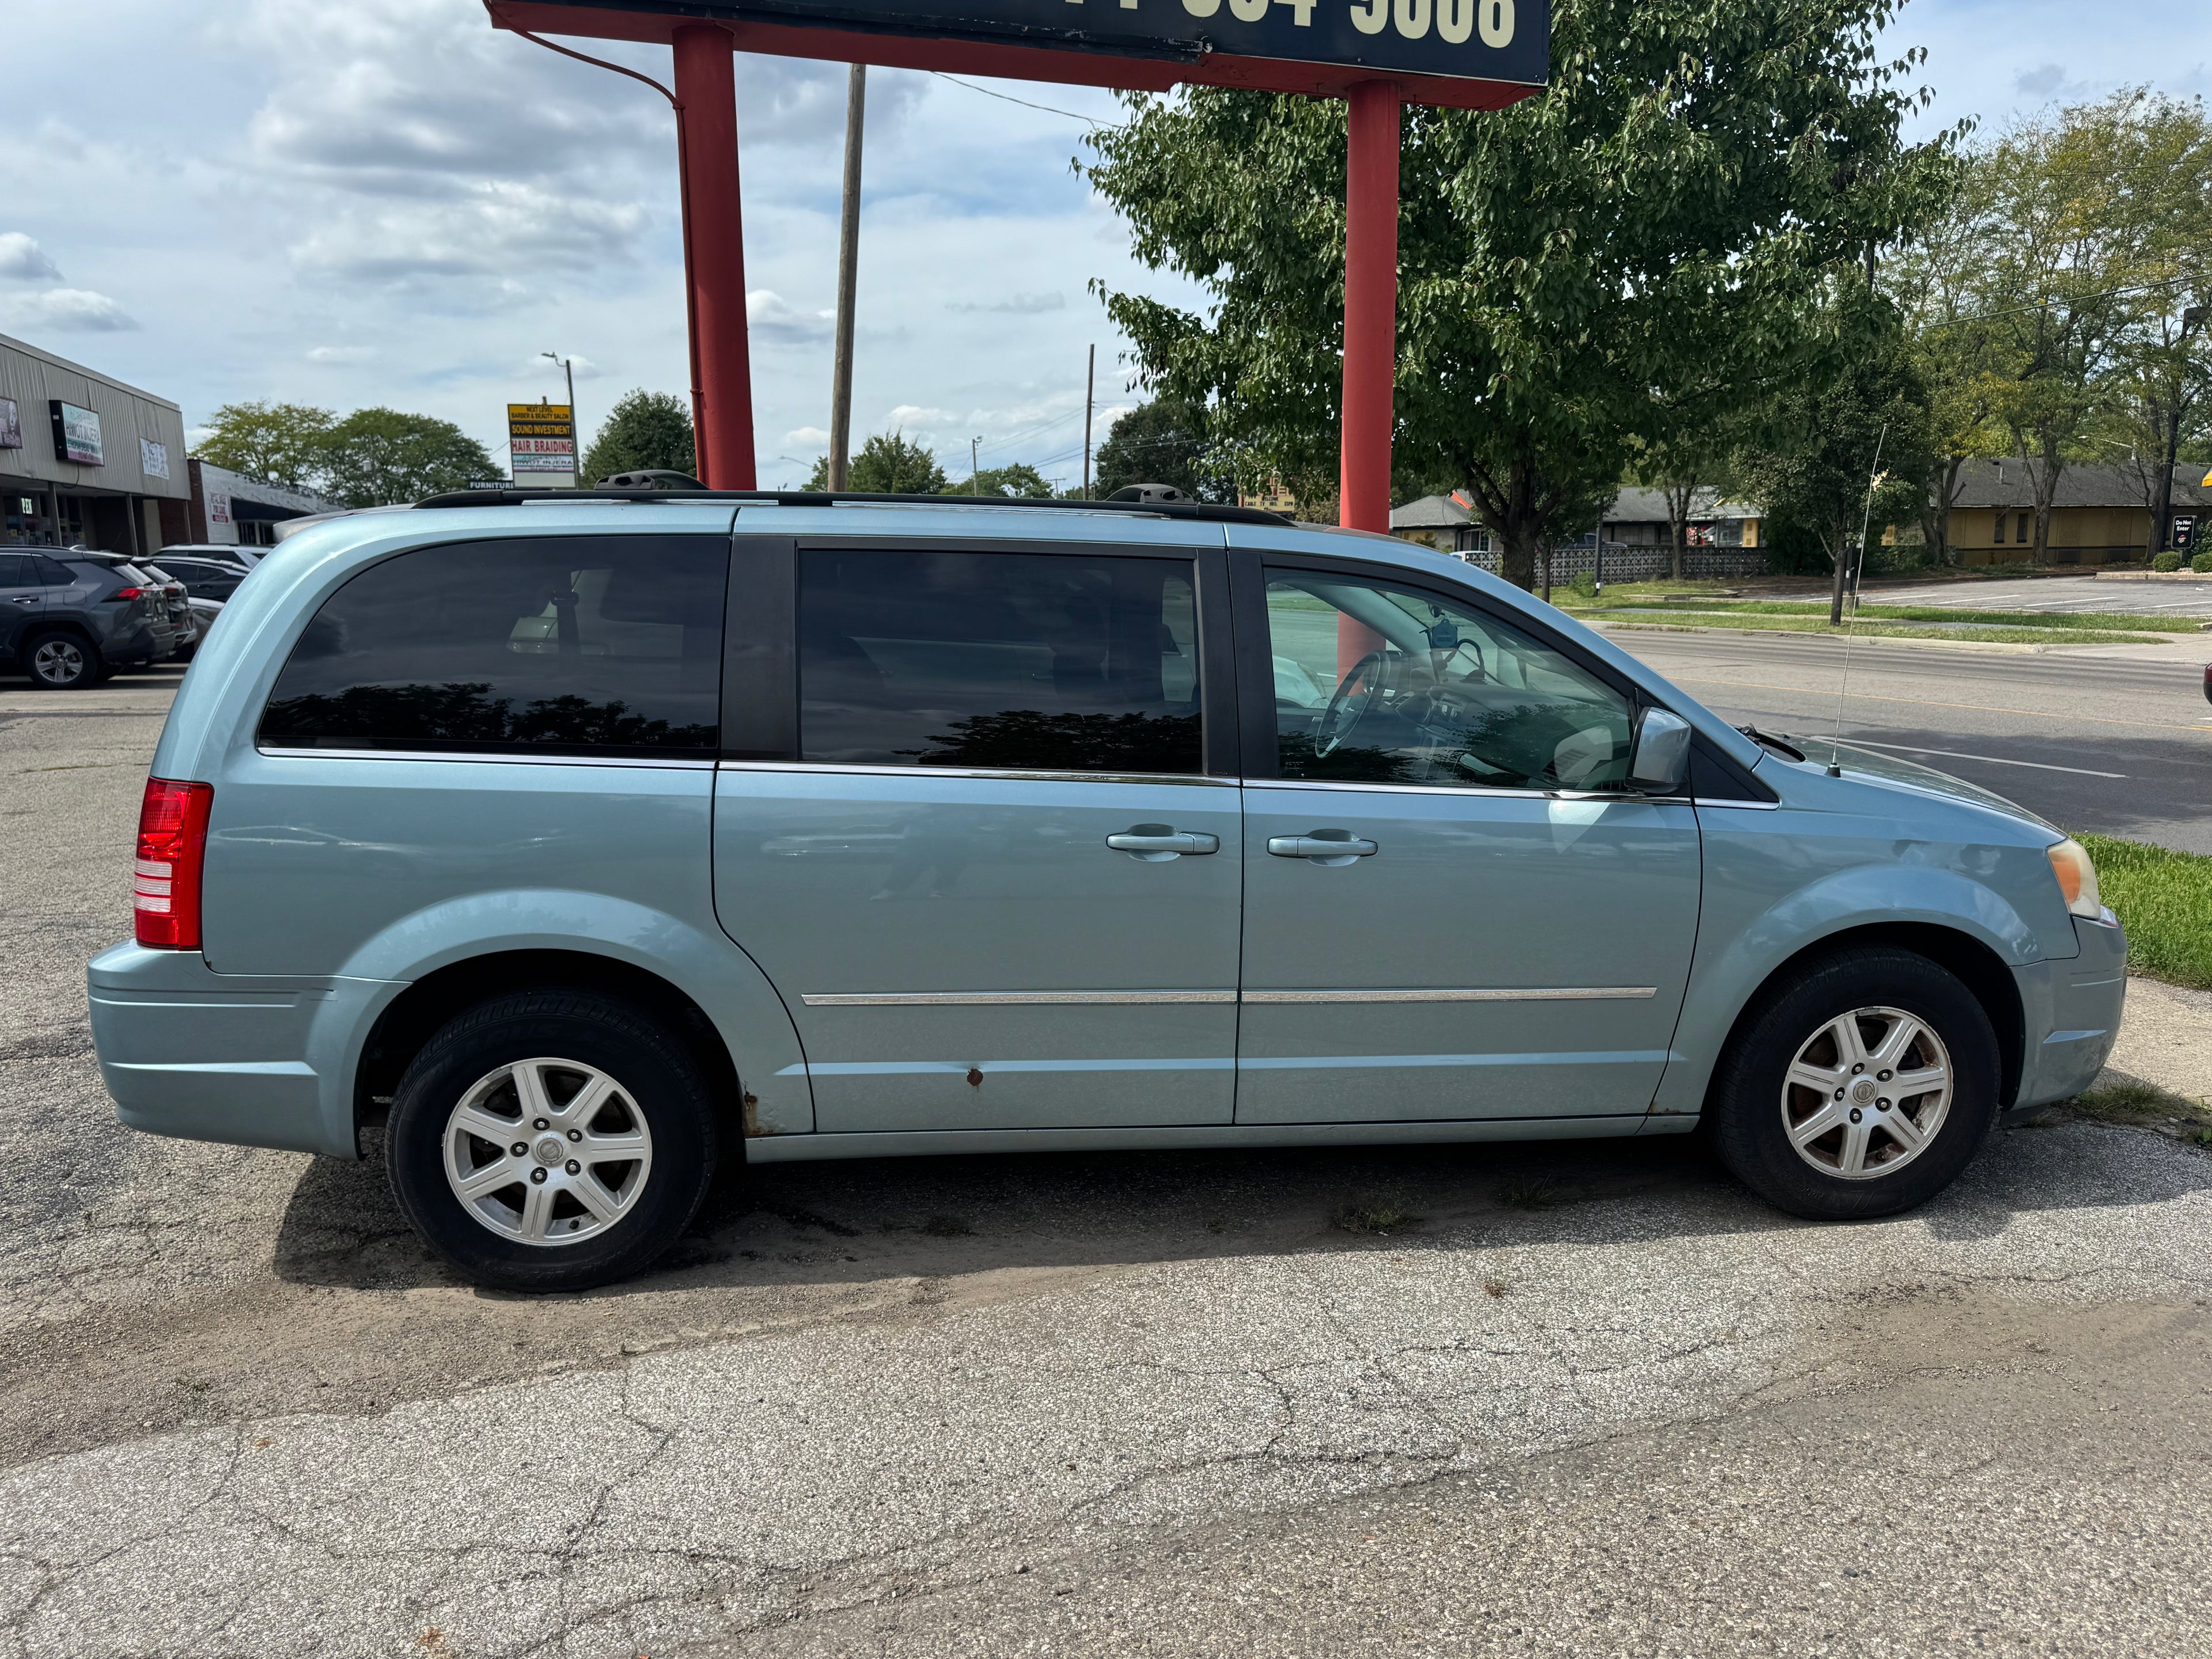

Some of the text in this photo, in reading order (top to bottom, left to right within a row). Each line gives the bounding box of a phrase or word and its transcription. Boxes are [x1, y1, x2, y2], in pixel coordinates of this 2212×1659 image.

[512, 425, 570, 434] SOUND INVESTMENT
[512, 440, 573, 453] HAIR BRAIDING
